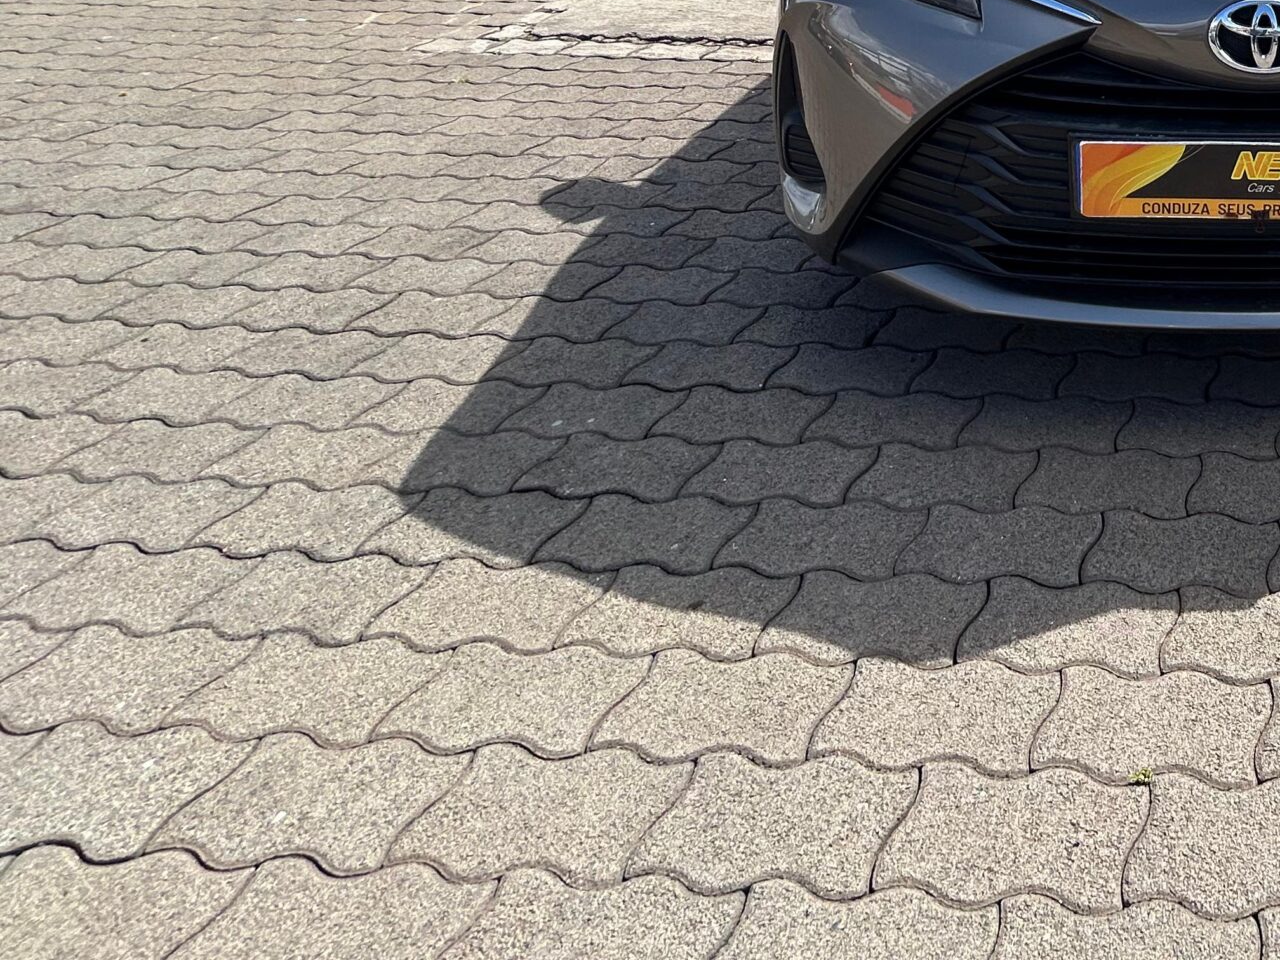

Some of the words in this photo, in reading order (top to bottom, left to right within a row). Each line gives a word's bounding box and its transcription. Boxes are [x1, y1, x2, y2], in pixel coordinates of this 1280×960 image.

[1247, 182, 1275, 193] Cars
[1142, 202, 1210, 215] CONDUZA
[1218, 203, 1255, 216] SEUS
